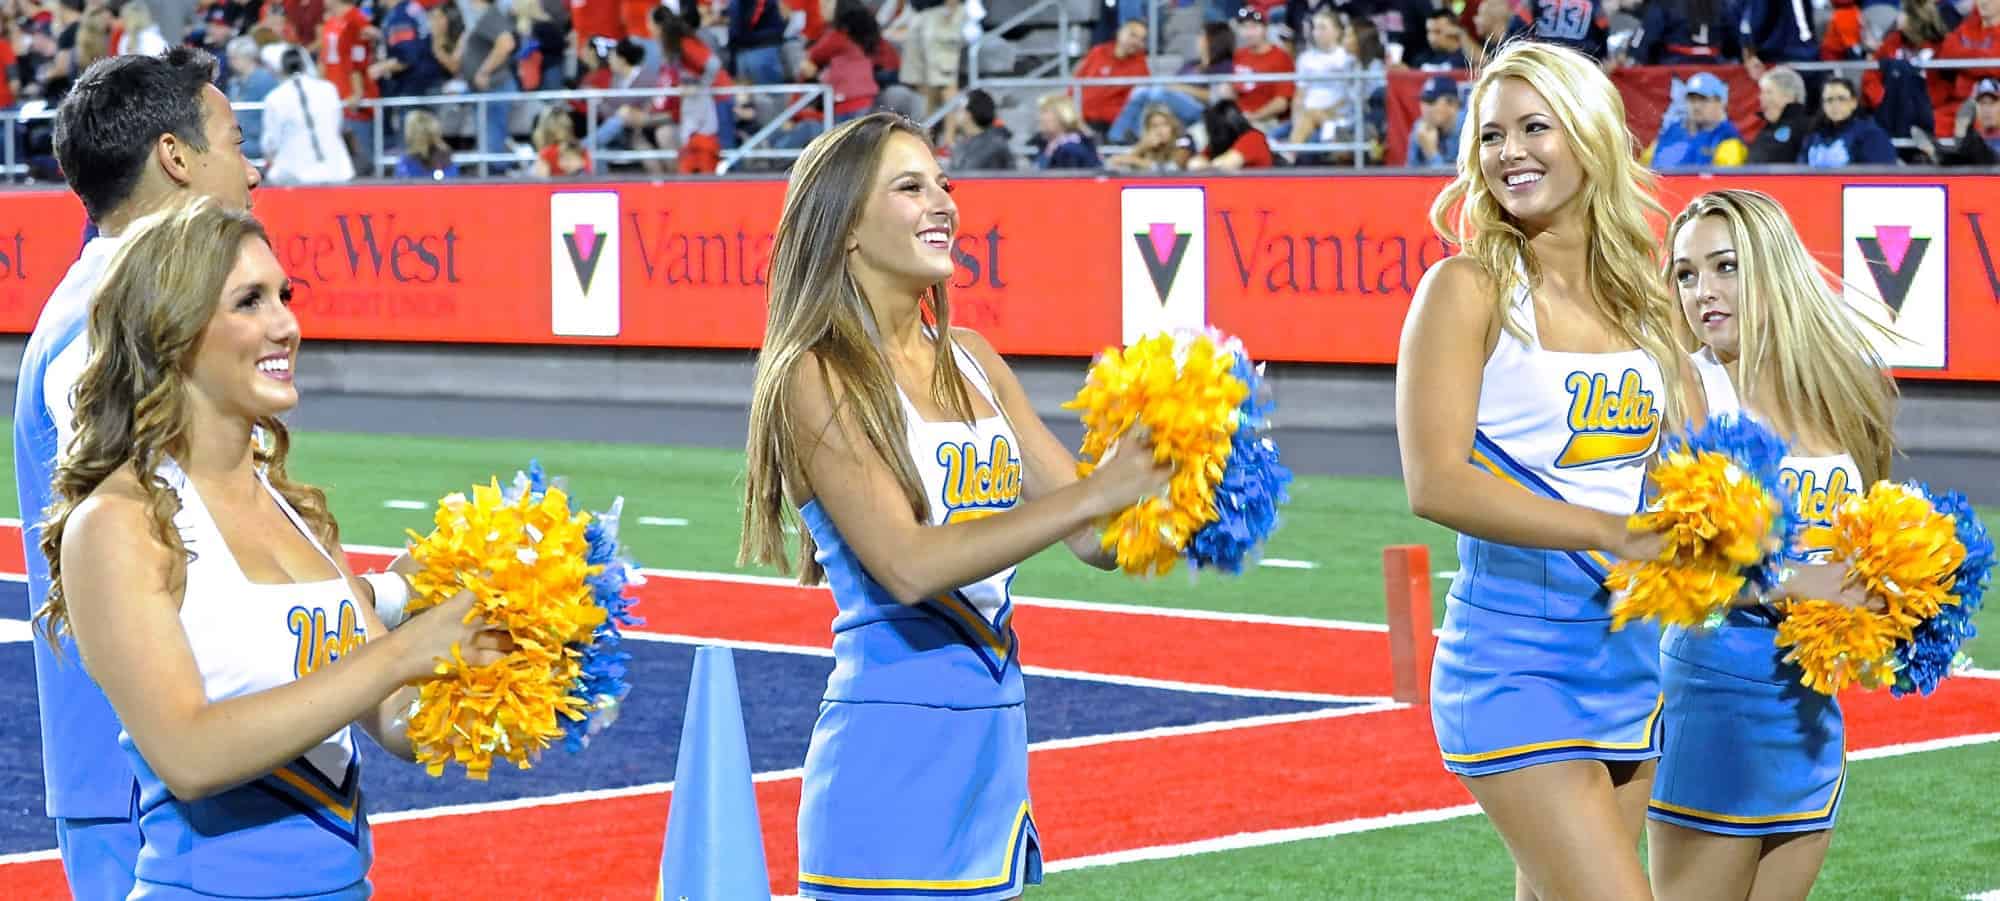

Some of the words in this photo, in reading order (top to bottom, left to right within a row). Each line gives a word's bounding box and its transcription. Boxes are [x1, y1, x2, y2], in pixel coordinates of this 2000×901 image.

[276, 212, 461, 290] geWest
[1565, 368, 1655, 434] Ucla
[936, 435, 1022, 509] Ucla
